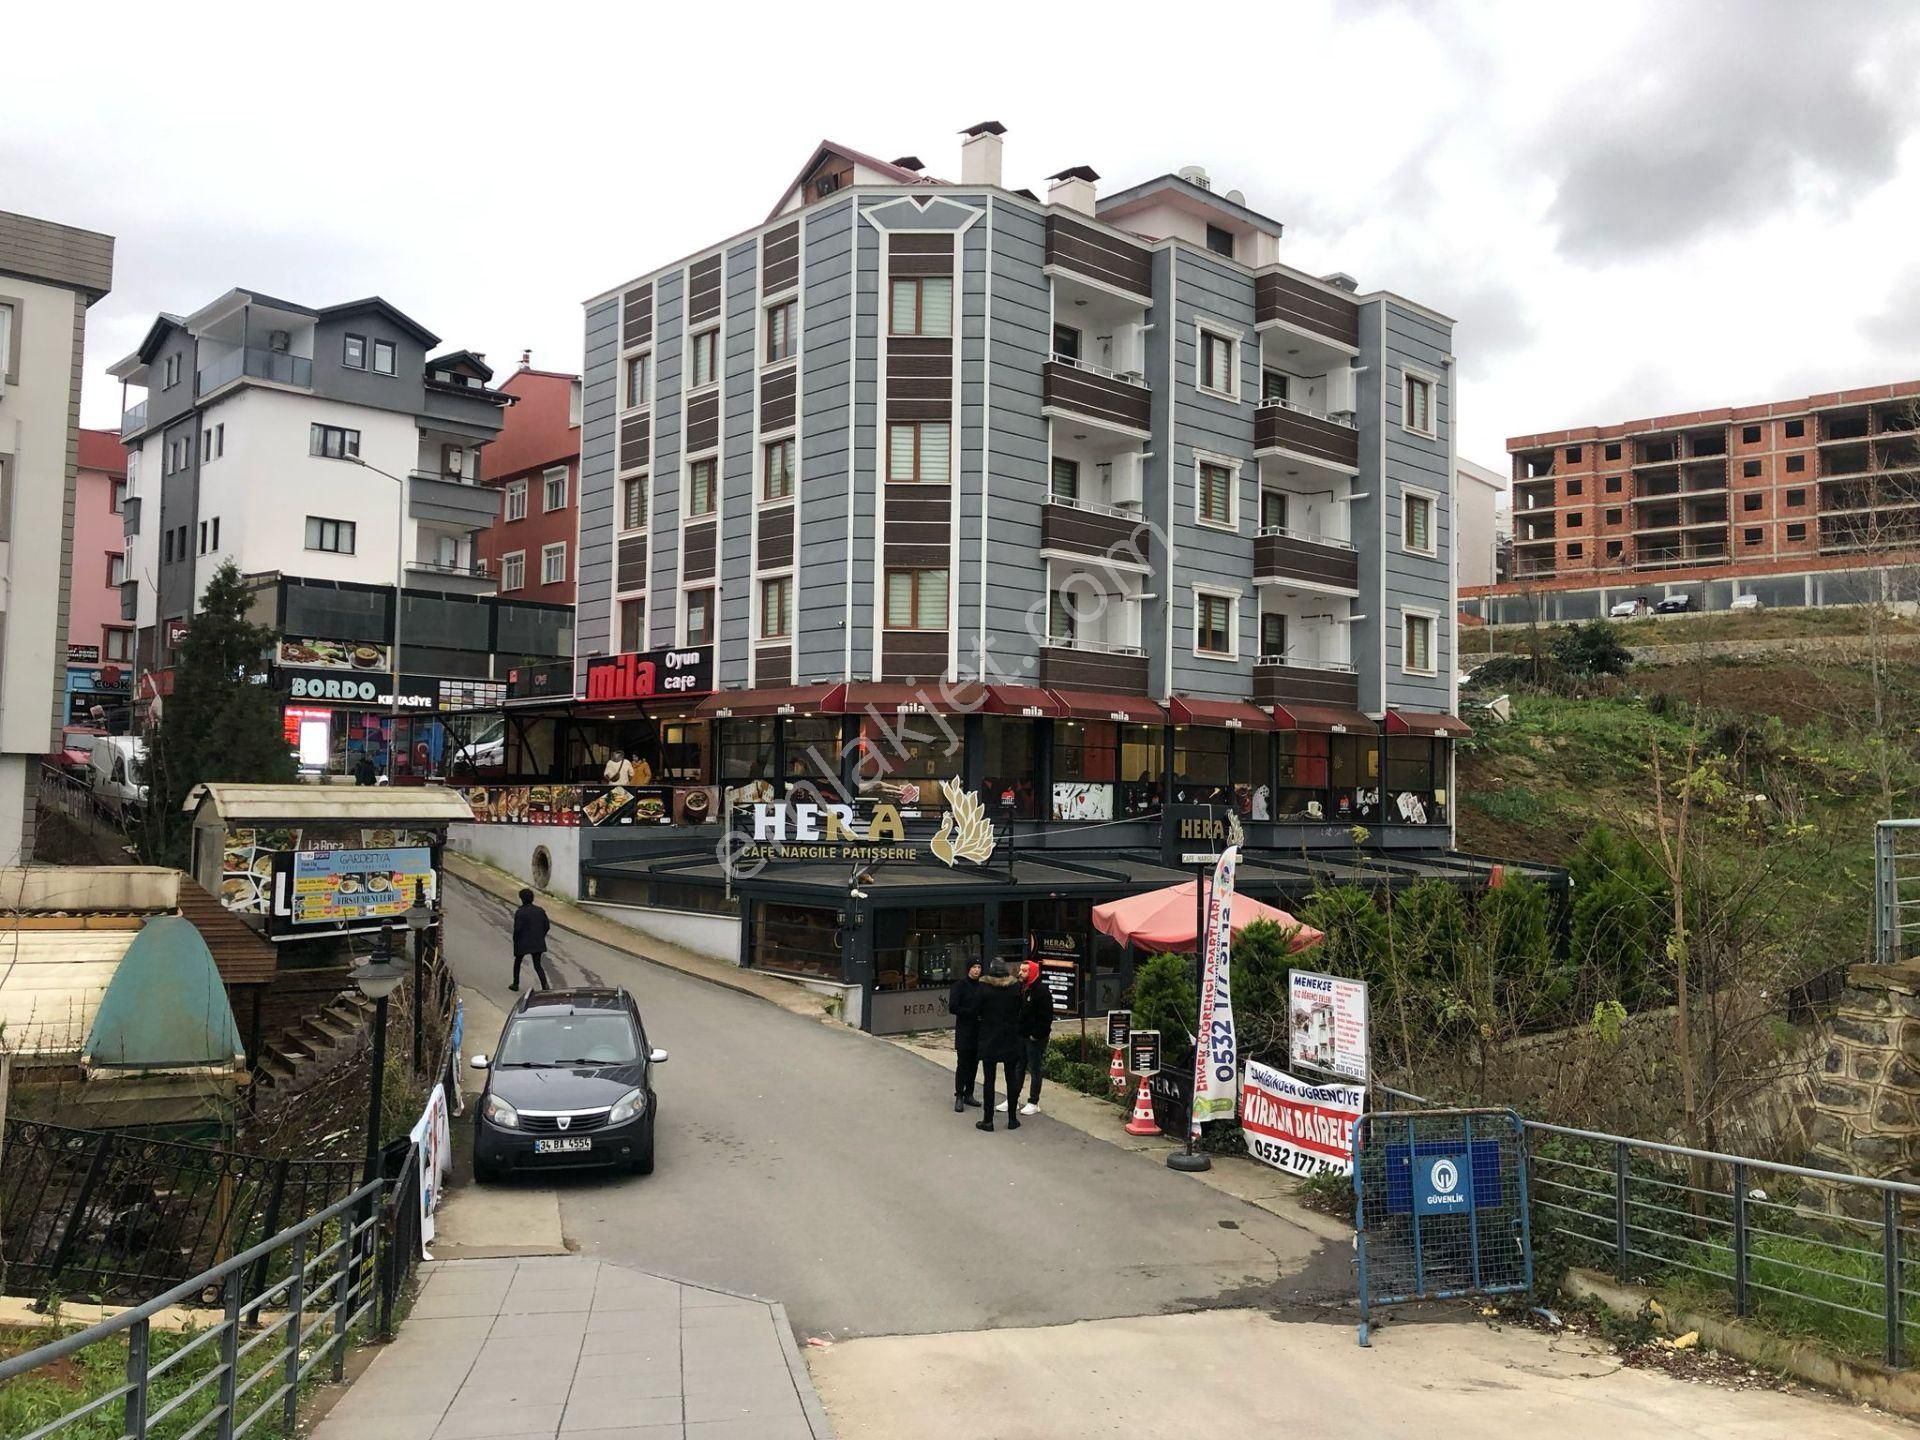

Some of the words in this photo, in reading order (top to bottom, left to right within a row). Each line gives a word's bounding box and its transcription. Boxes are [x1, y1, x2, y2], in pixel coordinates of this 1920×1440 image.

[665, 651, 700, 669] Oyun
[589, 654, 656, 699] mila
[664, 674, 696, 691] cafe
[291, 677, 376, 700] BORDO
[716, 707, 732, 718] mila
[777, 702, 795, 715] mila
[897, 703, 925, 714] mila
[1022, 706, 1043, 717] mila
[1111, 711, 1129, 721] mila
[1226, 717, 1242, 728] mila
[1332, 723, 1346, 733] mila
[1434, 728, 1448, 737] mila
[754, 803, 905, 842] HERA
[1181, 818, 1224, 839] HERA
[743, 846, 775, 858] CAFE
[781, 846, 836, 858] NARGILE
[842, 846, 917, 860] PATISSERIE
[903, 1003, 935, 1015] HERA
[1211, 1020, 1234, 1082] 0532
[1294, 1106, 1354, 1152] DAİRELE
[540, 1140, 551, 1150] 34
[1254, 1139, 1291, 1166] 0532
[1293, 1151, 1316, 1174] 177
[1427, 1193, 1464, 1204] GÜVENLİK
